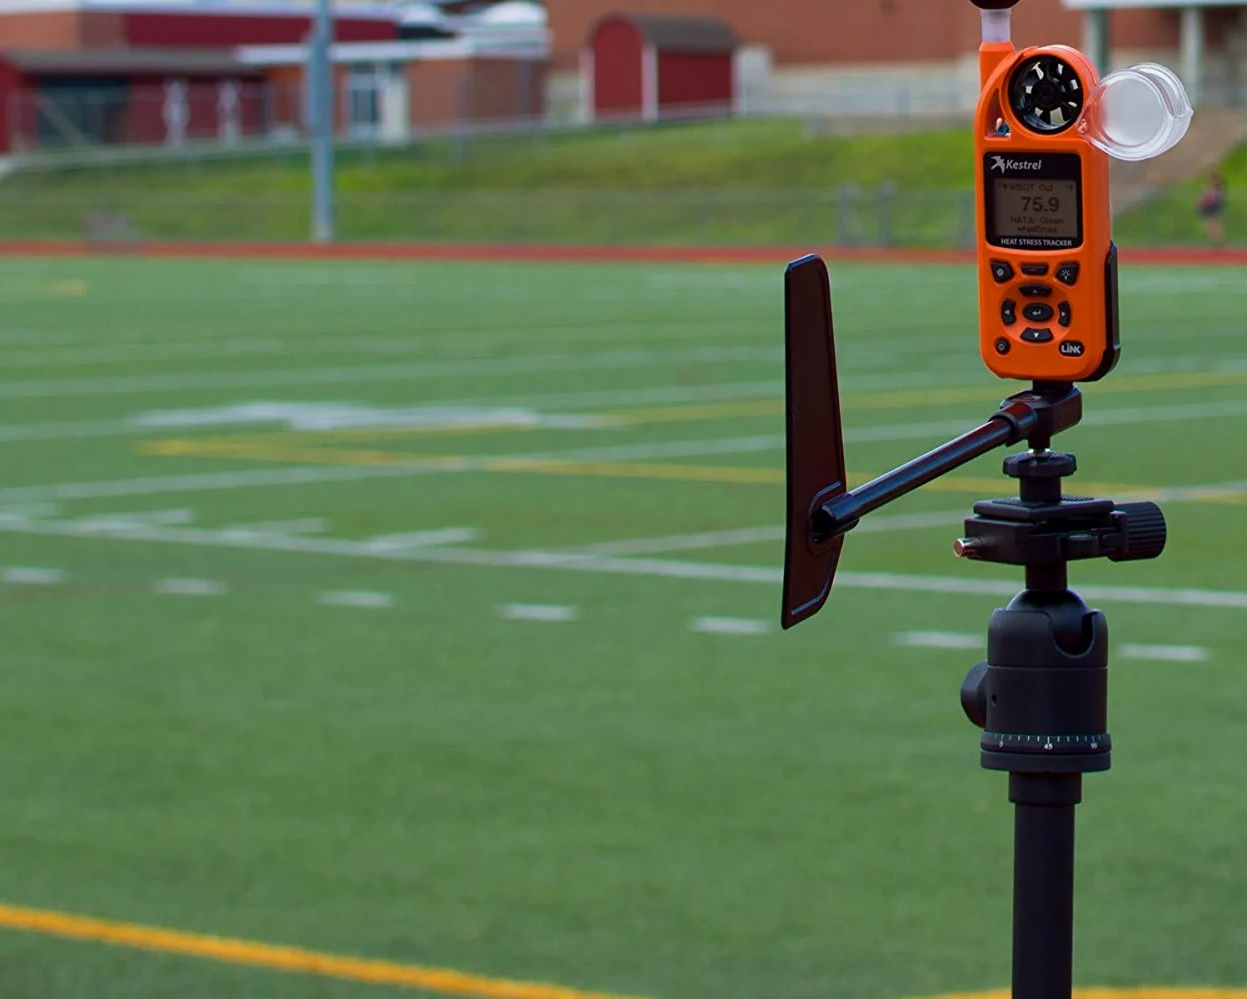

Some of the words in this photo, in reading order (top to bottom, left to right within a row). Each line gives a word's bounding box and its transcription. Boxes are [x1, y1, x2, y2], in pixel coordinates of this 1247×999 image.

[1005, 159, 1042, 170] Kestrel
[1020, 196, 1059, 212] 75.9
[1000, 238, 1018, 246] HEAT
[1018, 238, 1042, 247] STRESS
[1043, 239, 1072, 247] TRACKER
[1044, 742, 1053, 750] 45
